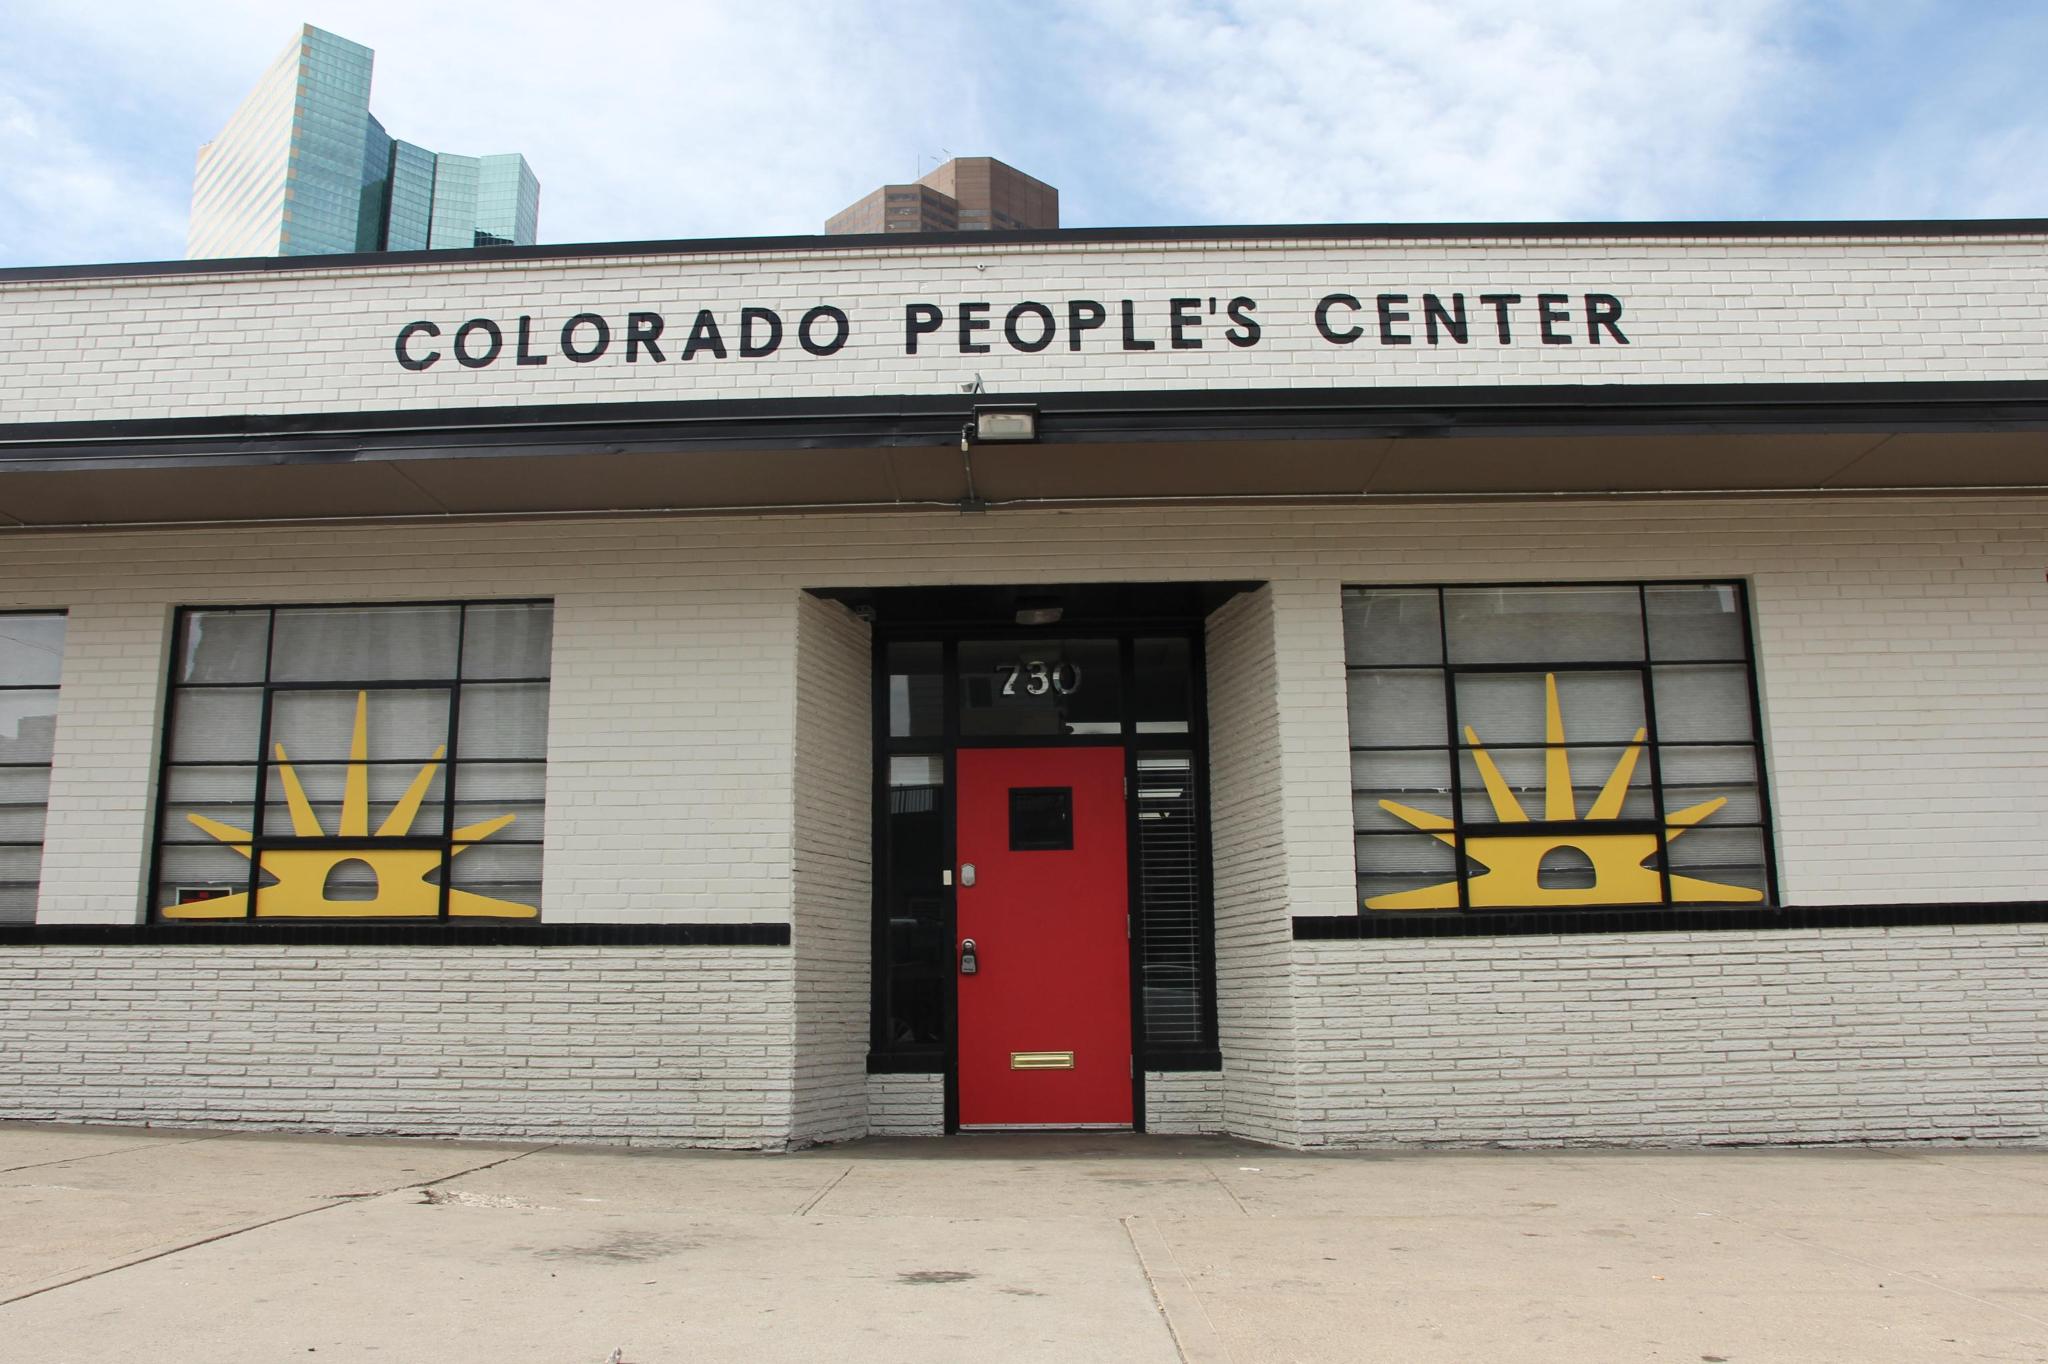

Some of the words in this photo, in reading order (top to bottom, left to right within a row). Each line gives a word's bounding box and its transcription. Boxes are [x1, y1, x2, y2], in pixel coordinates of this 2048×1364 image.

[395, 304, 850, 371] COLORADO
[905, 297, 1261, 355] PEOPLE'S
[1314, 292, 1630, 346] CENTER
[995, 661, 1081, 695] 730
